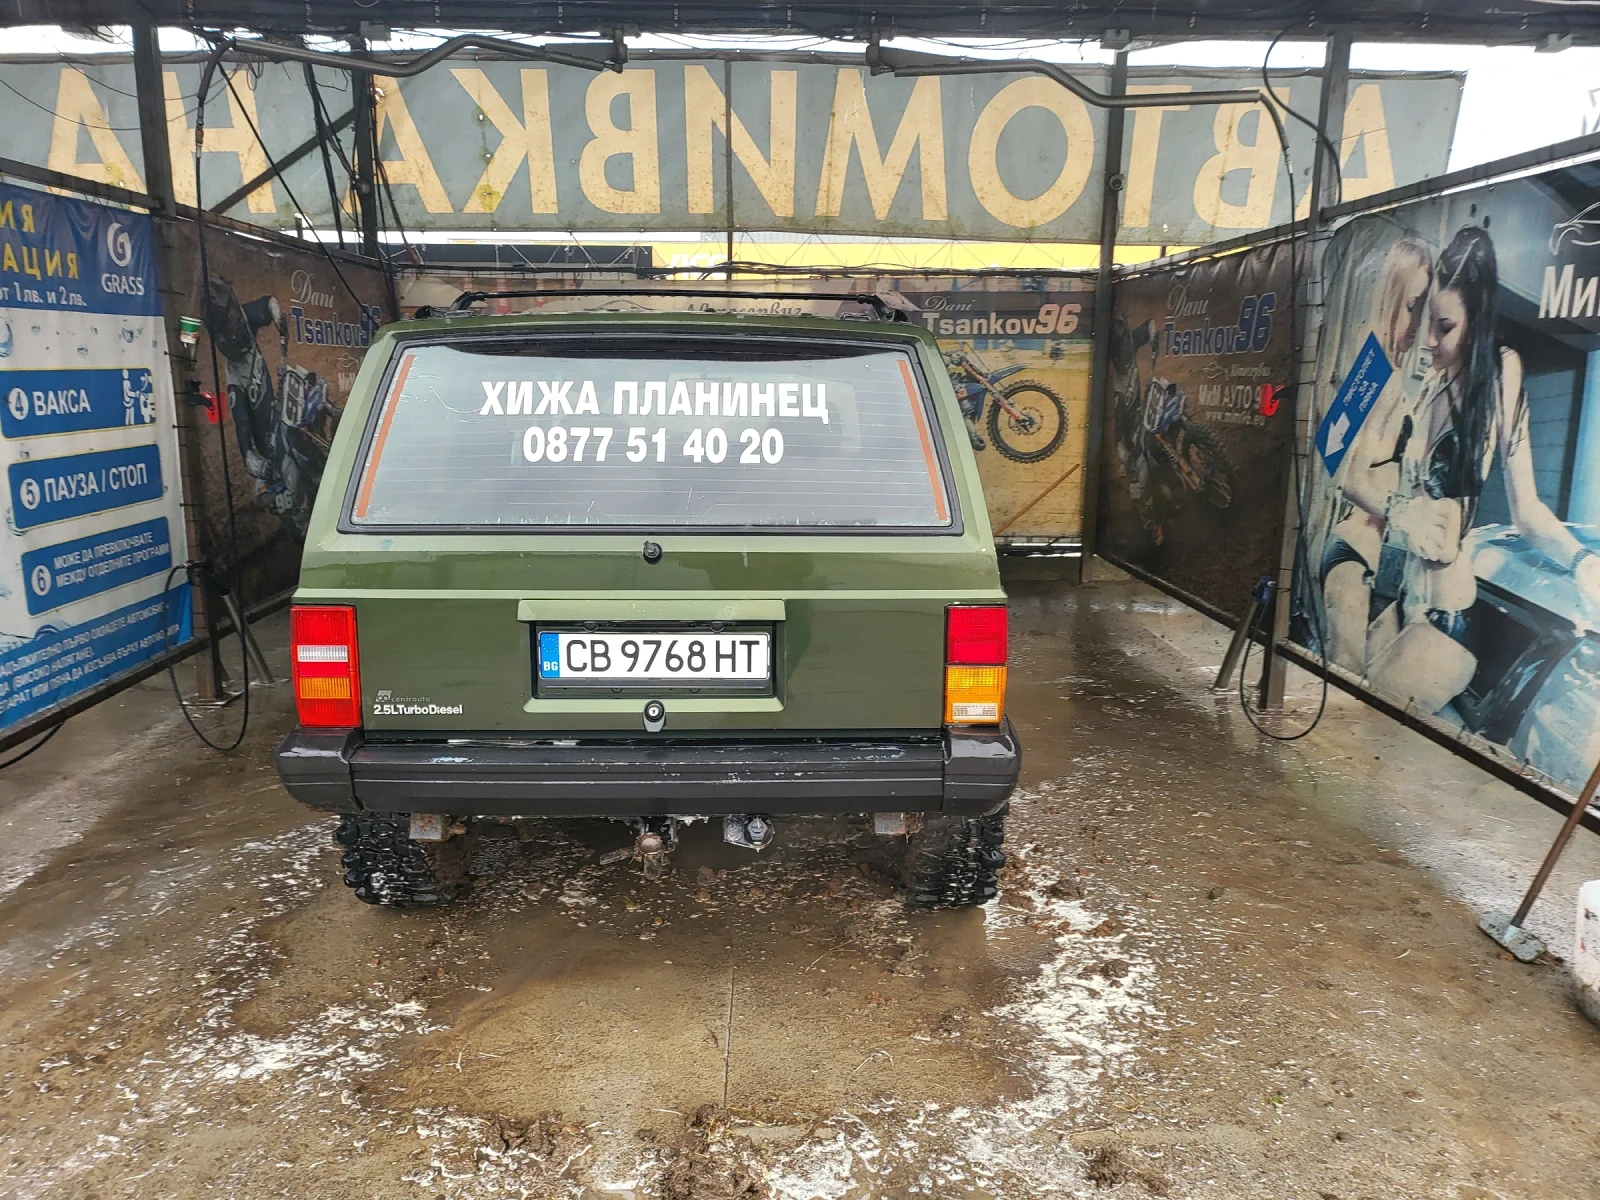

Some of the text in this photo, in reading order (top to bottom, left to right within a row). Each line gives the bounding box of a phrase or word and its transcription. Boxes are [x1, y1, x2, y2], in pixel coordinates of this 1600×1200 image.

[3, 242, 79, 281] АЦИЯ
[101, 273, 145, 296] GRASS
[290, 270, 336, 308] Dani
[1164, 284, 1213, 318] Dani
[1538, 264, 1600, 318] Ми
[924, 295, 975, 312] Dani
[12, 389, 91, 418] 4 ВАКСА
[479, 380, 829, 424] ХИЖА ПЛАНИНЕЦ
[523, 426, 784, 464] 0877 51 40 20
[23, 480, 38, 508] 5
[44, 471, 100, 502] ПАУЗА
[109, 463, 148, 490] СТОП
[34, 566, 49, 594] 6
[543, 661, 559, 671] BG
[620, 640, 706, 673] 9768
